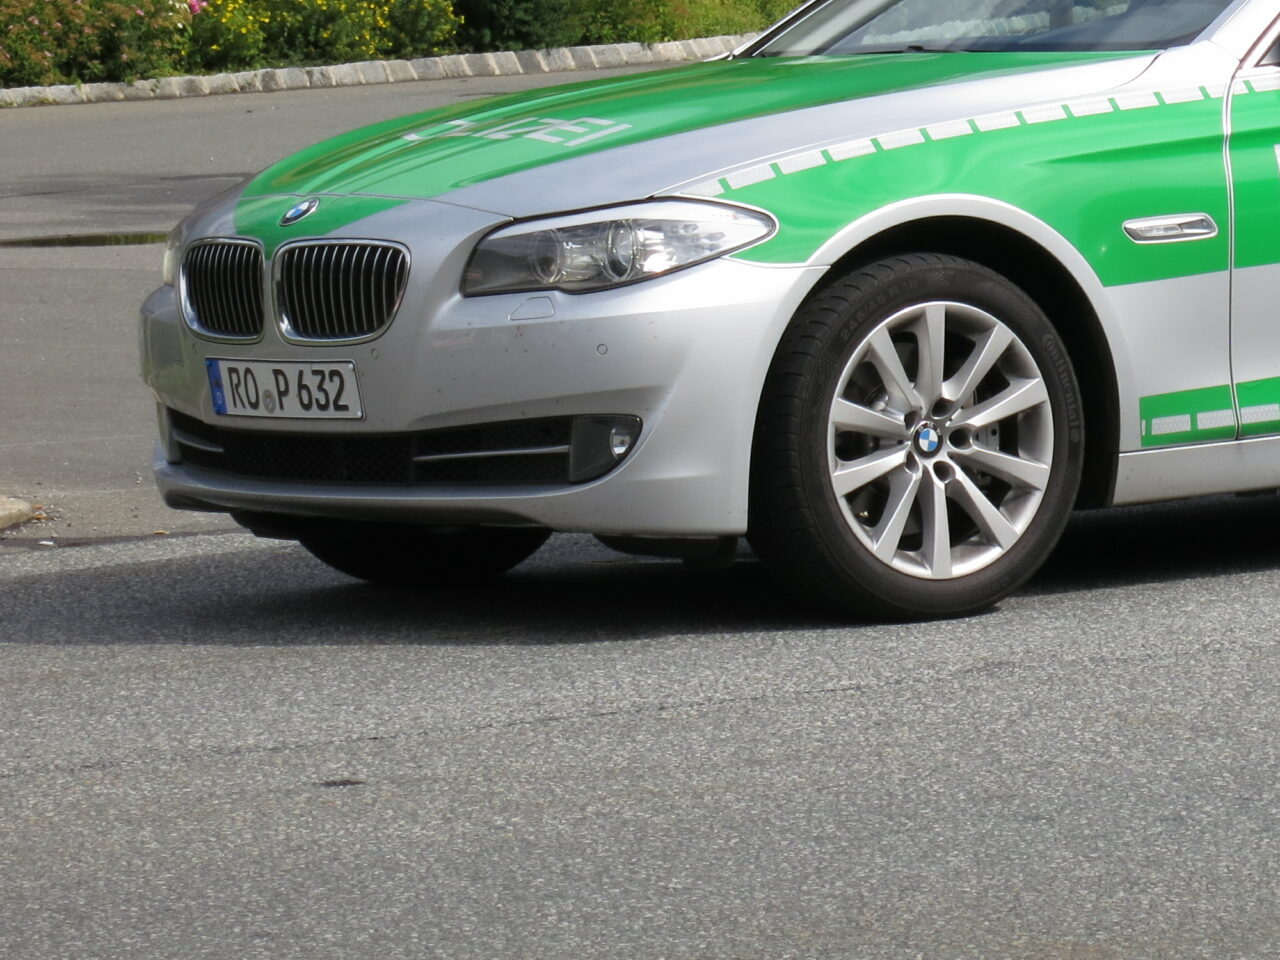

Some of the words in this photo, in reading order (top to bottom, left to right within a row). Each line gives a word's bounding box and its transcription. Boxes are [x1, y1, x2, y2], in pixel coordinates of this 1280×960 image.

[402, 118, 632, 147] OLIZEI
[227, 366, 260, 410] RO
[272, 368, 290, 410] P
[298, 369, 349, 411] 632
[1043, 334, 1080, 428] Continental
